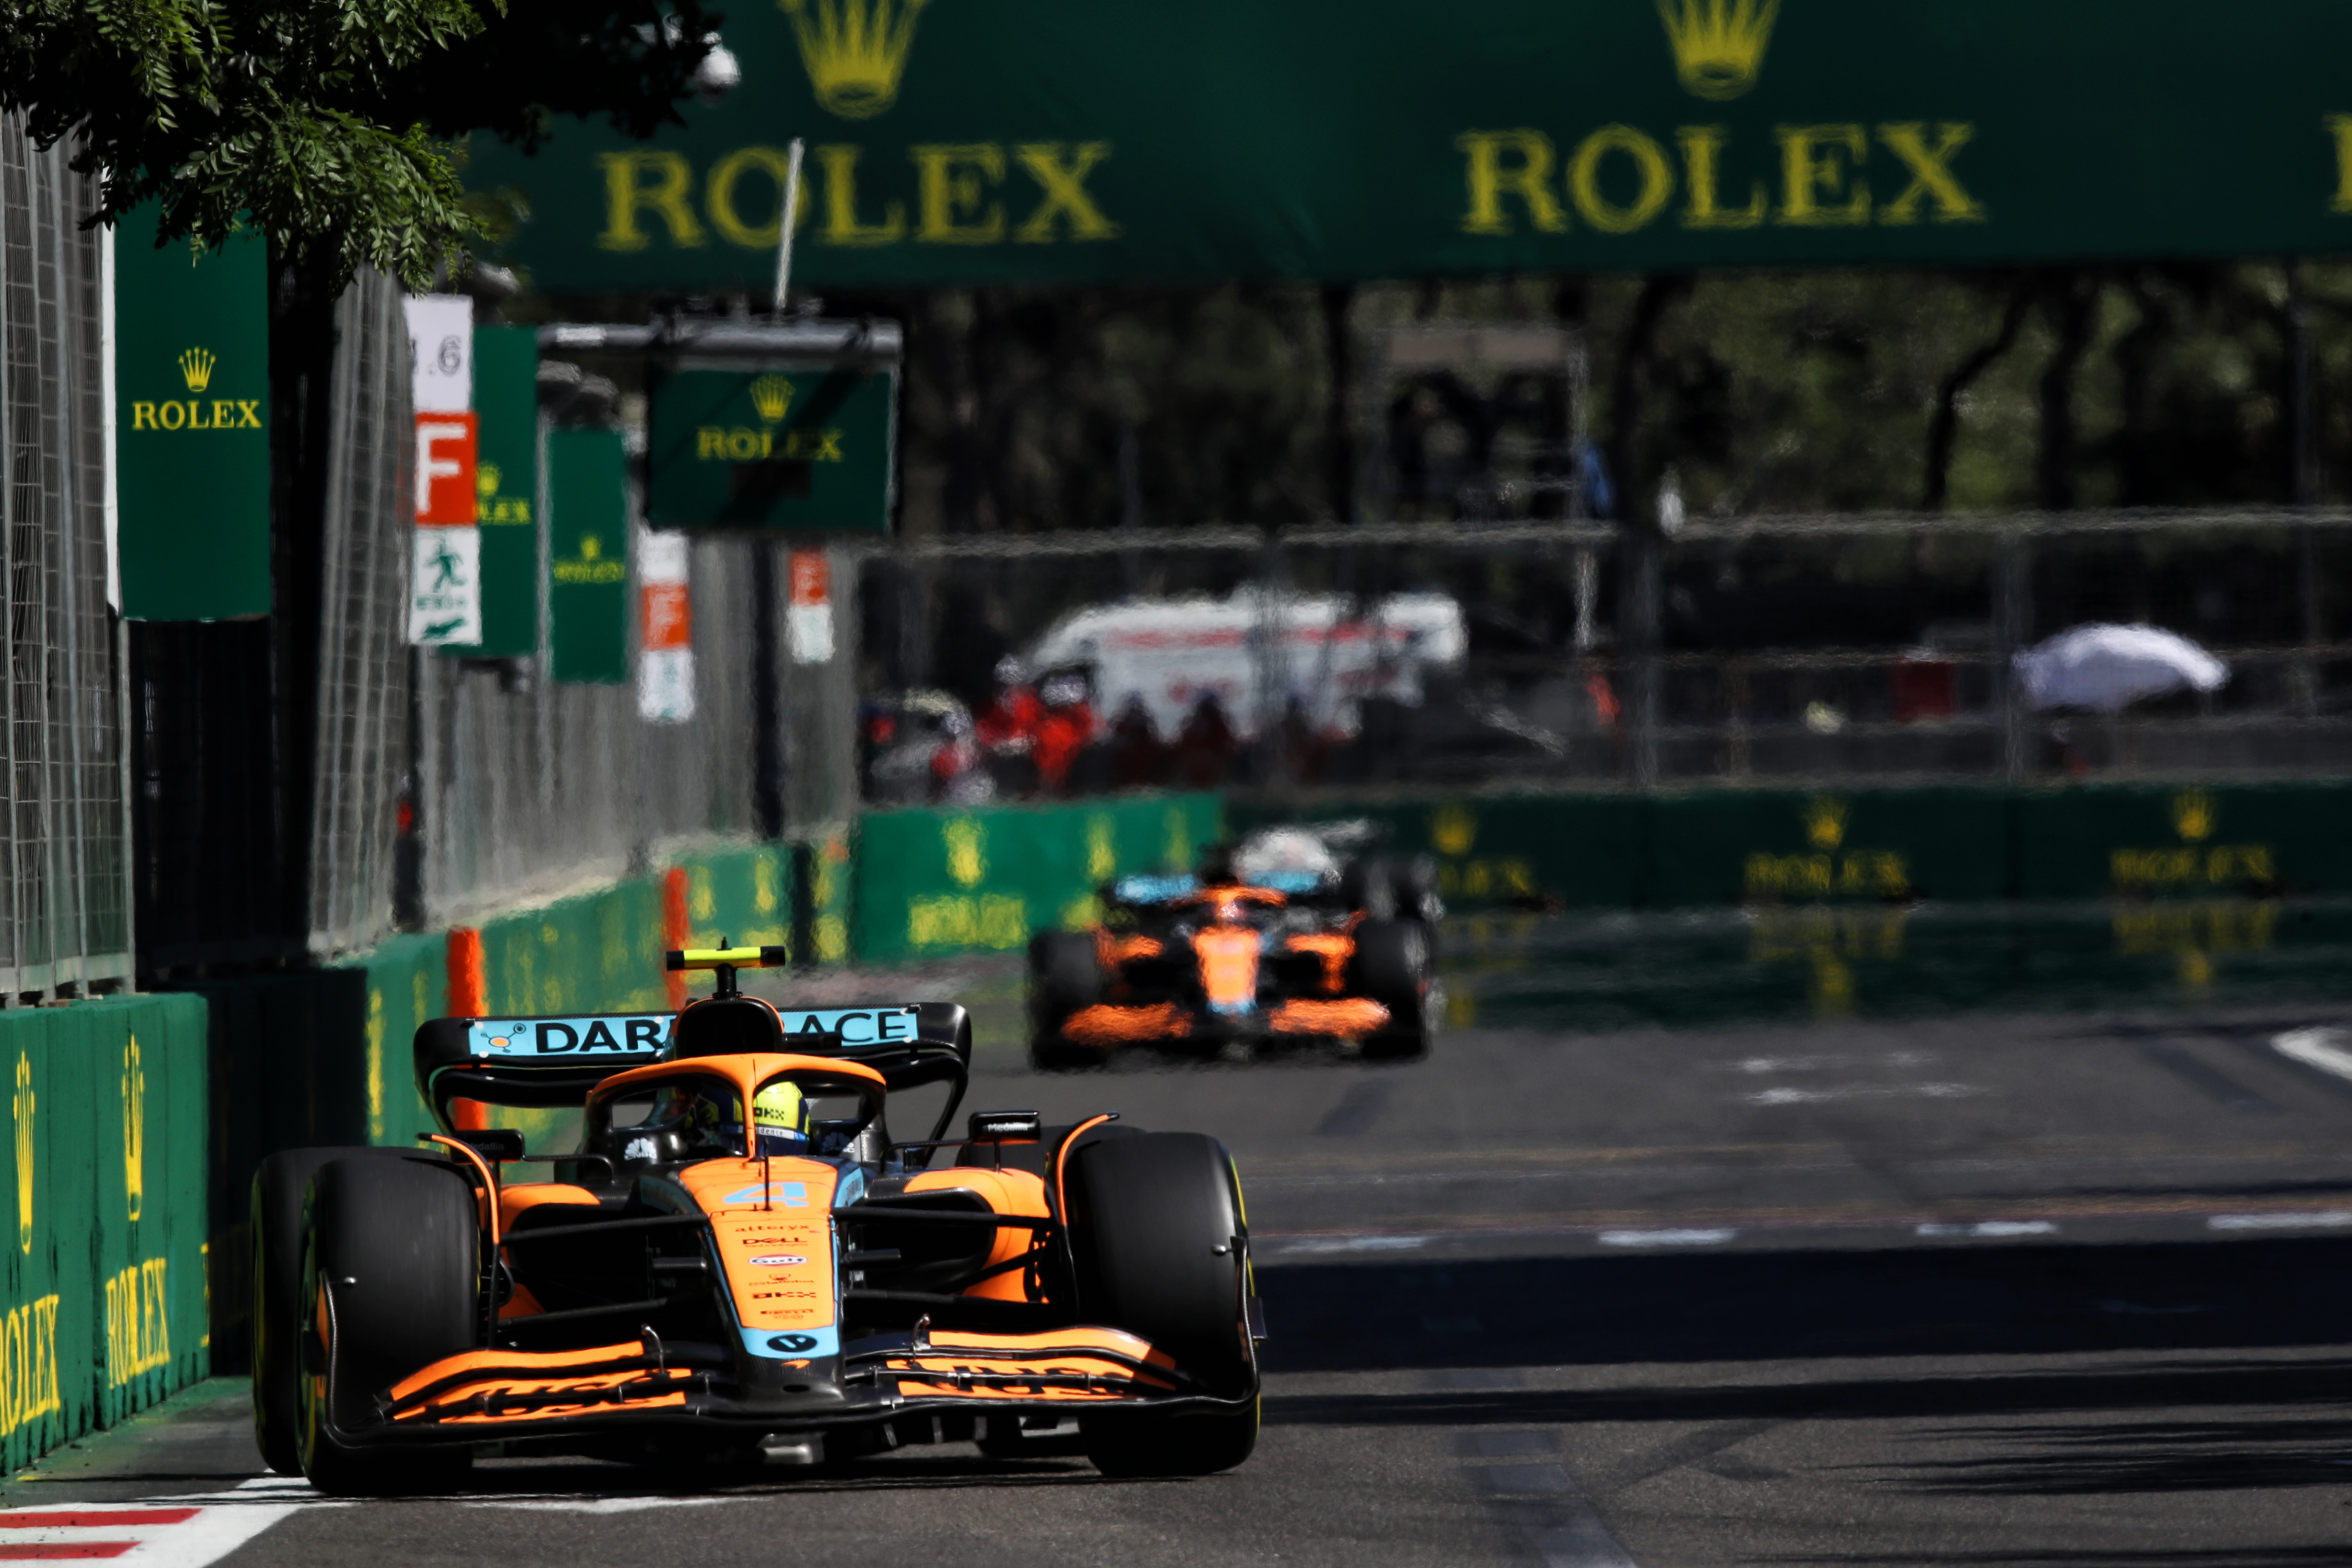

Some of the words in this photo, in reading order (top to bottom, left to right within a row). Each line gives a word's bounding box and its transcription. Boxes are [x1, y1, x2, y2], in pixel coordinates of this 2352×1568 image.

[597, 141, 1118, 251] ROLEX
[1455, 122, 1987, 234] ROLEX
[132, 400, 262, 430] ROLEX
[696, 426, 844, 462] ROLEX
[415, 423, 467, 515] F
[470, 1142, 504, 1151] edallia
[723, 1182, 808, 1207] 4
[106, 1257, 171, 1390] ROLEX
